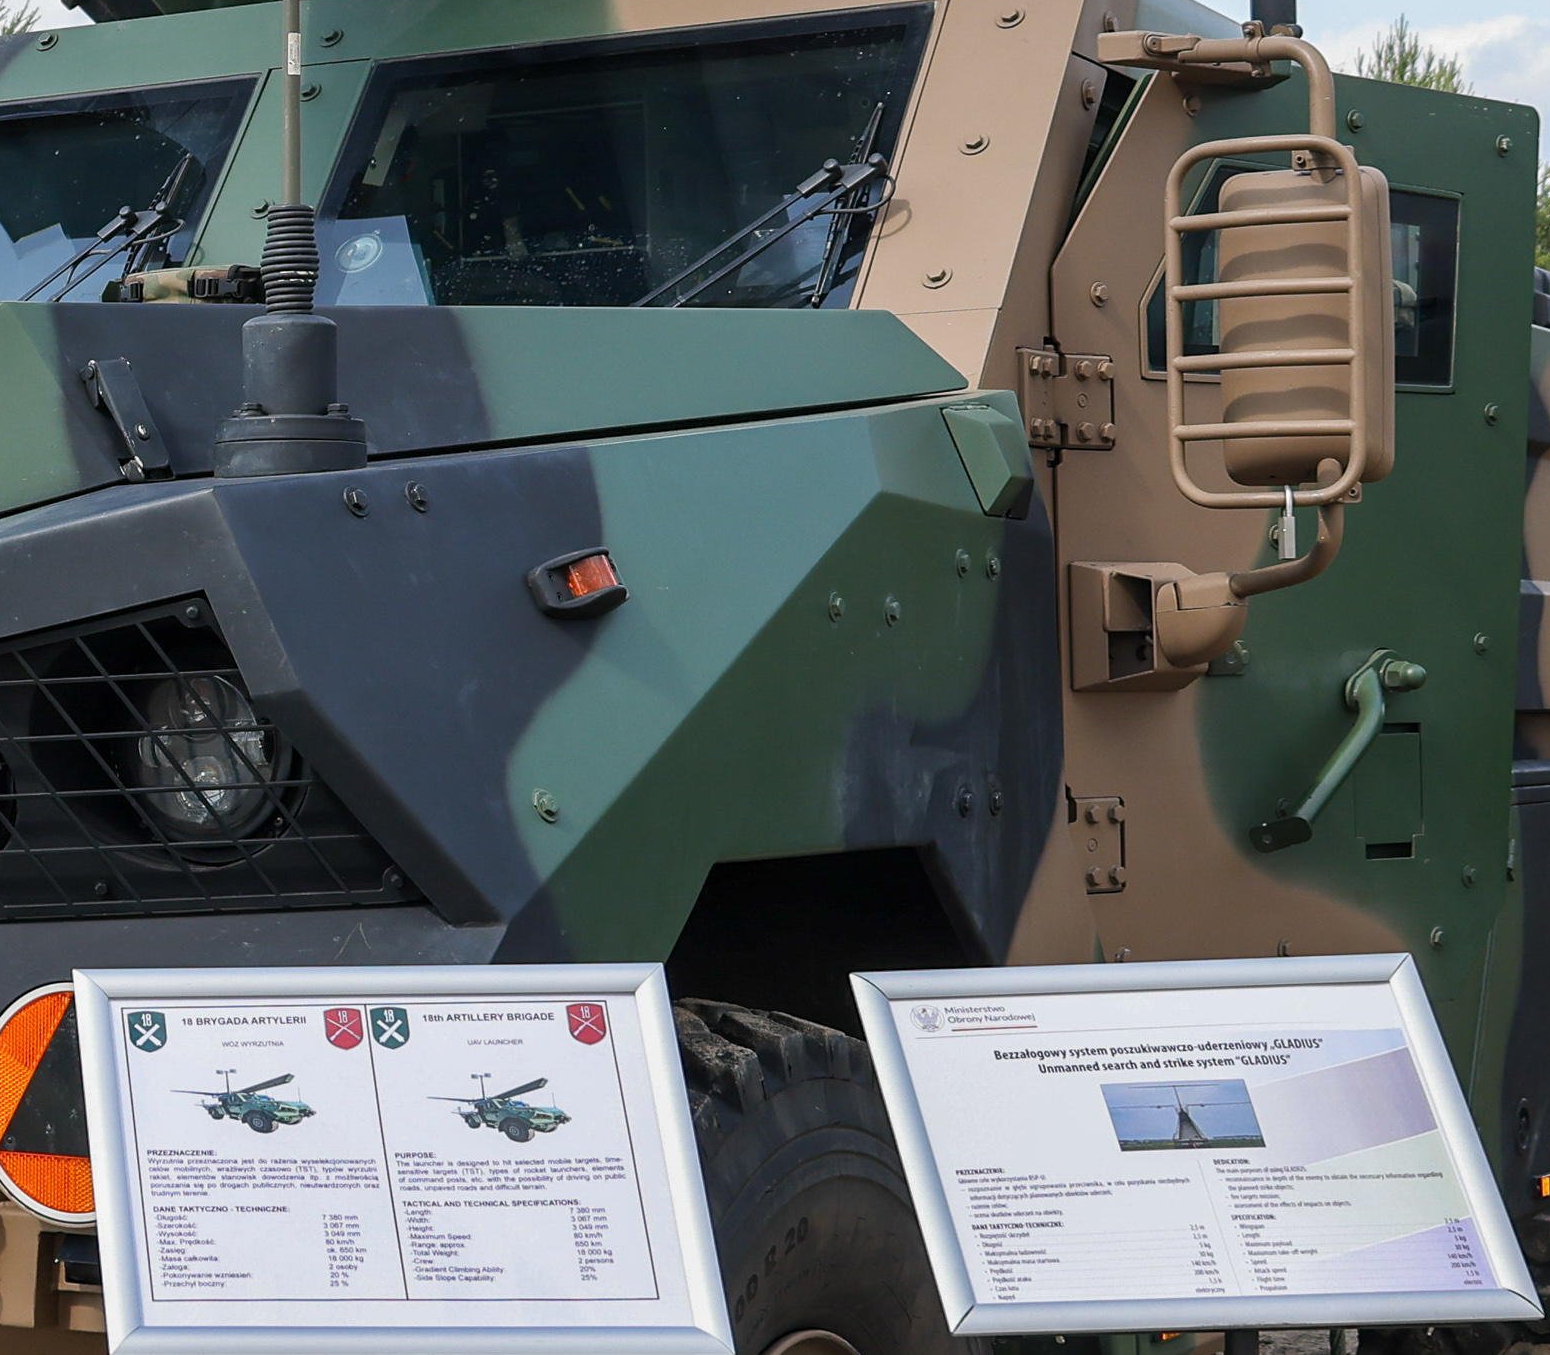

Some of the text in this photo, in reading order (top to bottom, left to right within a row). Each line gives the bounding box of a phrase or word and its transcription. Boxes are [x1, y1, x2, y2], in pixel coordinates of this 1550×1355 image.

[336, 1010, 348, 1024] 18
[384, 1009, 395, 1023] 18
[422, 1012, 555, 1022] 18th ARTILLERY BRIGADE
[580, 1005, 592, 1019] 18
[944, 1005, 1005, 1015] Ministerstwo
[141, 1013, 152, 1027] 18
[181, 1016, 307, 1026] 18 BRYGADA ARTYLERII
[947, 1012, 1036, 1024] Obrony Narodowej
[993, 1049, 1066, 1061] Bezzałogowy
[1069, 1046, 1108, 1058] system
[1110, 1039, 1268, 1057] poszukiwawczo-uderzeniowy
[1037, 1061, 1100, 1074] Unmanned
[1102, 1059, 1138, 1071] search
[1140, 1058, 1161, 1070] and
[1163, 1057, 1194, 1069] strike
[1196, 1057, 1235, 1070] system
